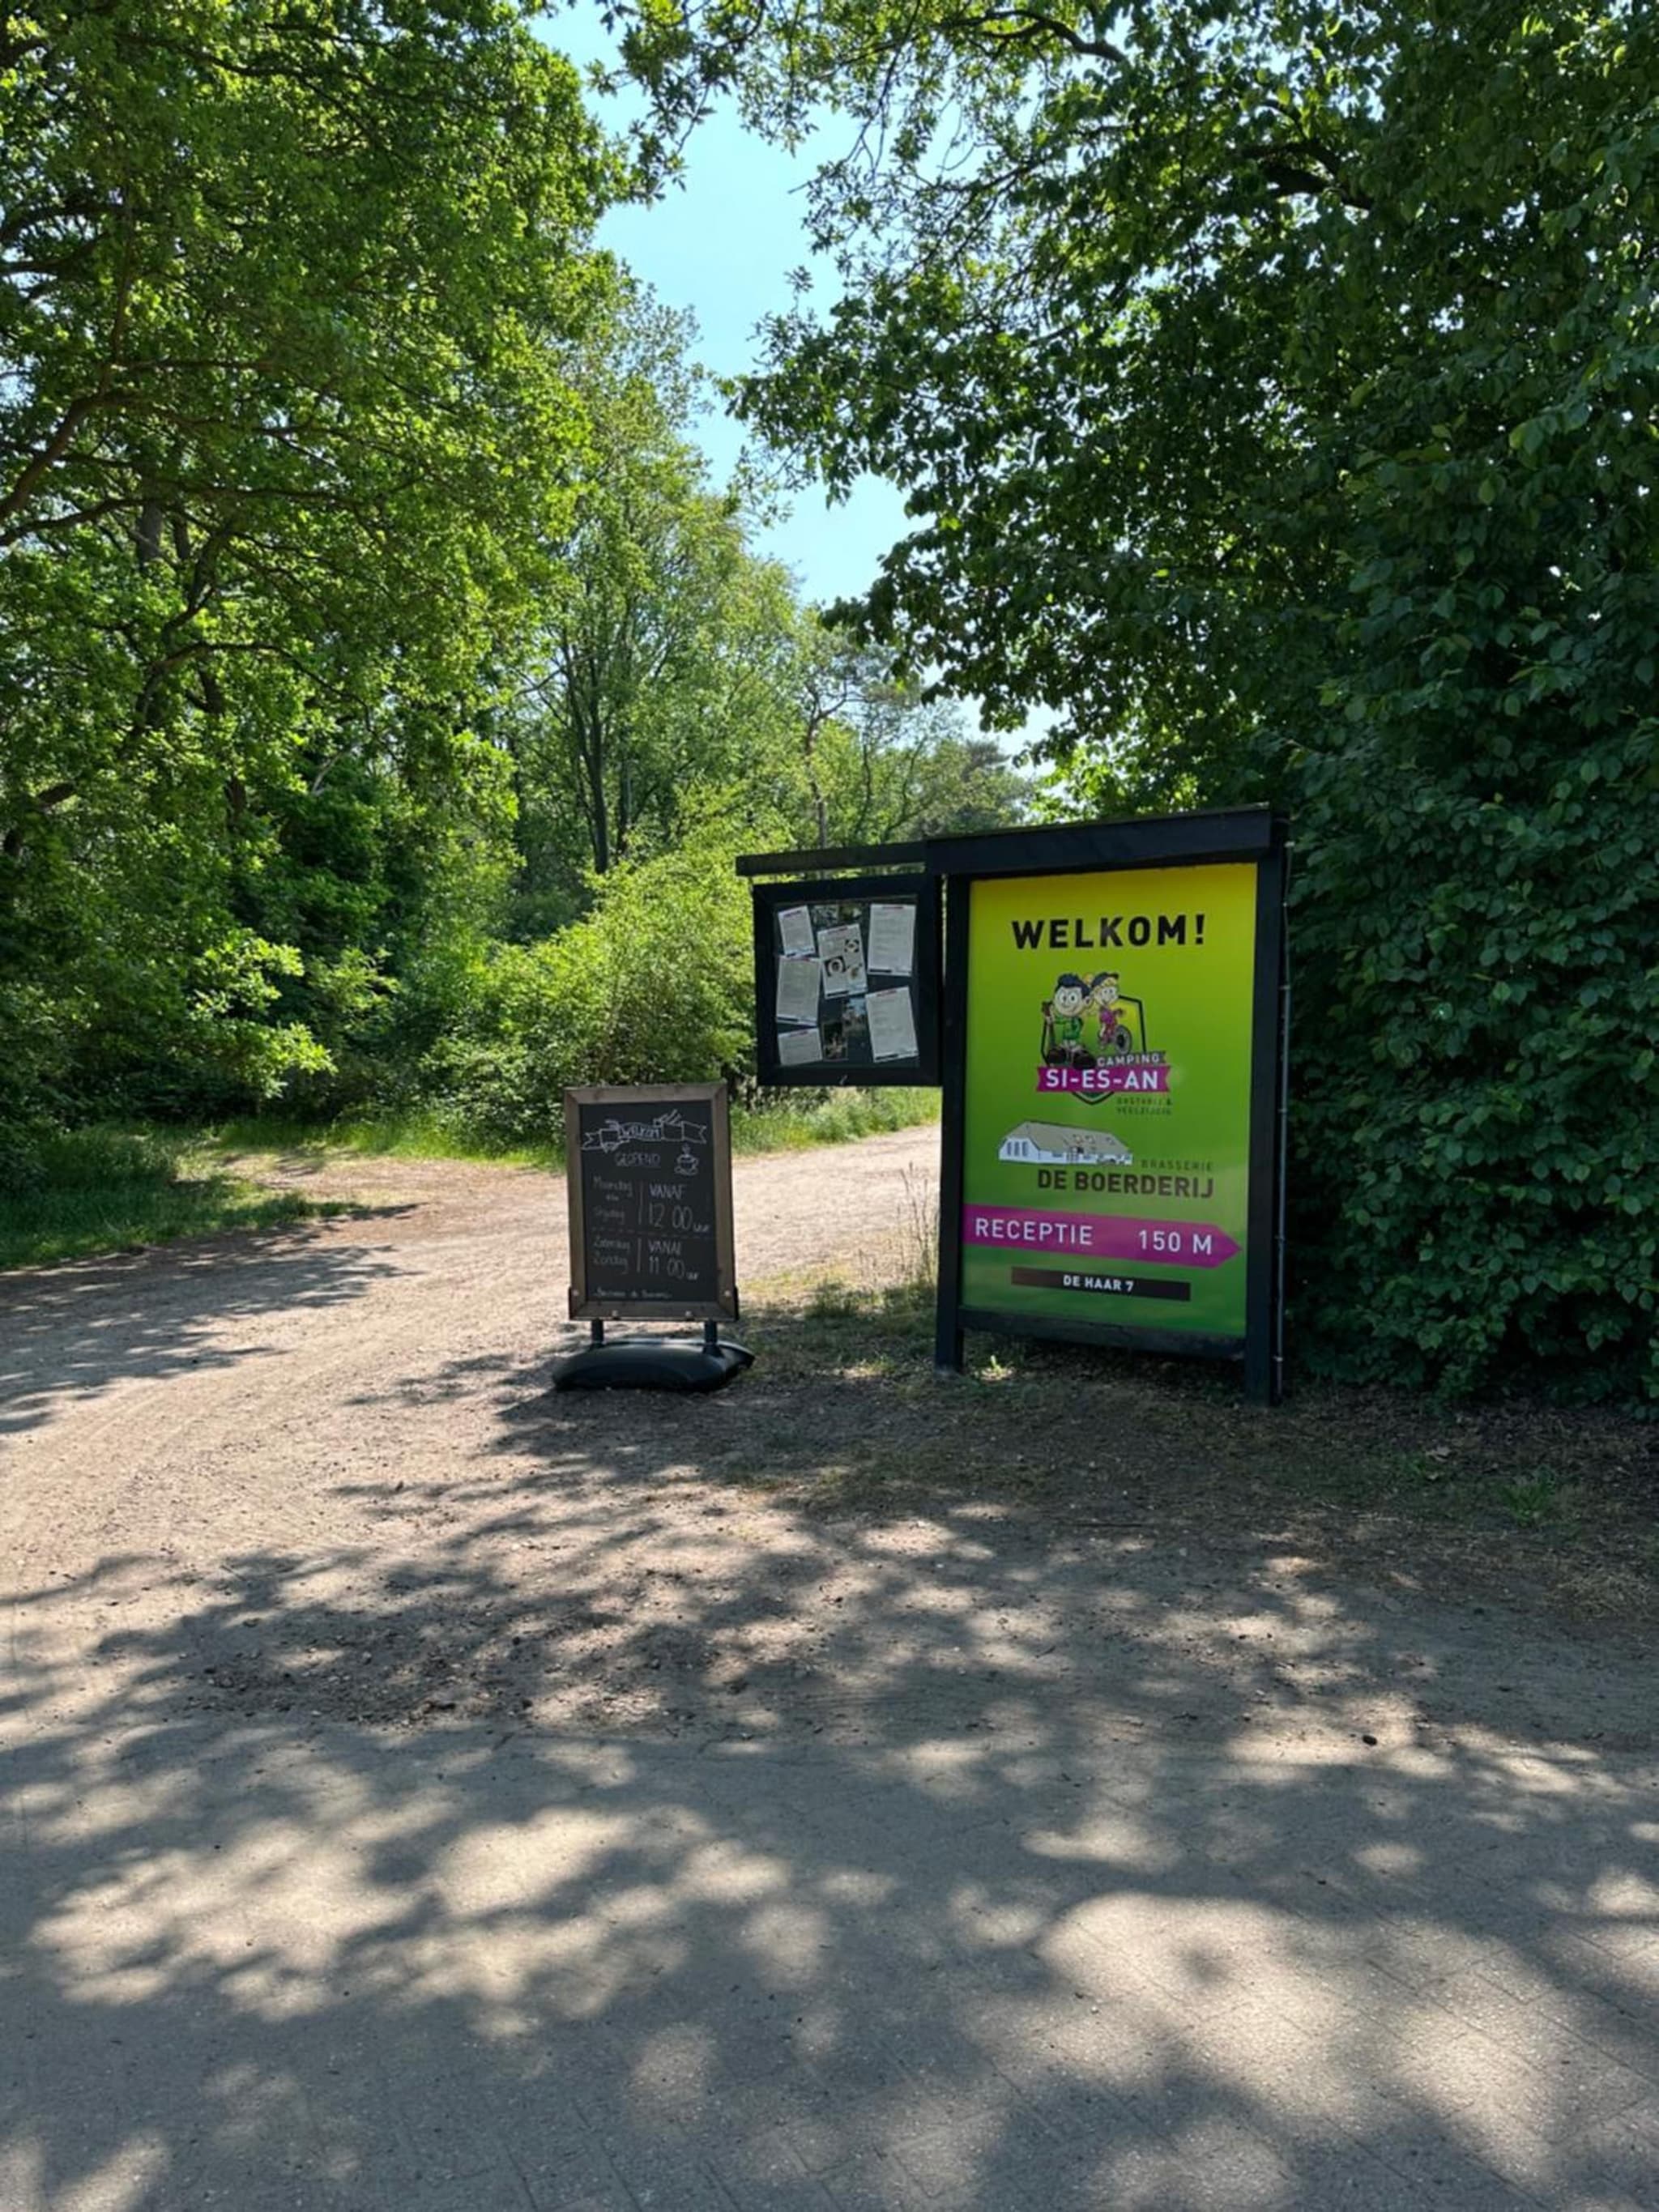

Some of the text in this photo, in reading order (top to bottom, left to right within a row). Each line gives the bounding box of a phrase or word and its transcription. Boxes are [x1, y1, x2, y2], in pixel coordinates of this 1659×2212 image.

[1012, 914, 1205, 949] WELKOM!
[1096, 1053, 1160, 1067] CAMPING
[1045, 1068, 1158, 1090] SI-ES-AN
[1141, 1159, 1213, 1171] BRASSERIE
[648, 1183, 687, 1200] VANAF
[1038, 1169, 1214, 1199] DE BOERDERIJ
[975, 1217, 1094, 1246] RECEPTIE
[1138, 1230, 1213, 1255] 150 M
[1063, 1274, 1134, 1292] DE HAAR 7
